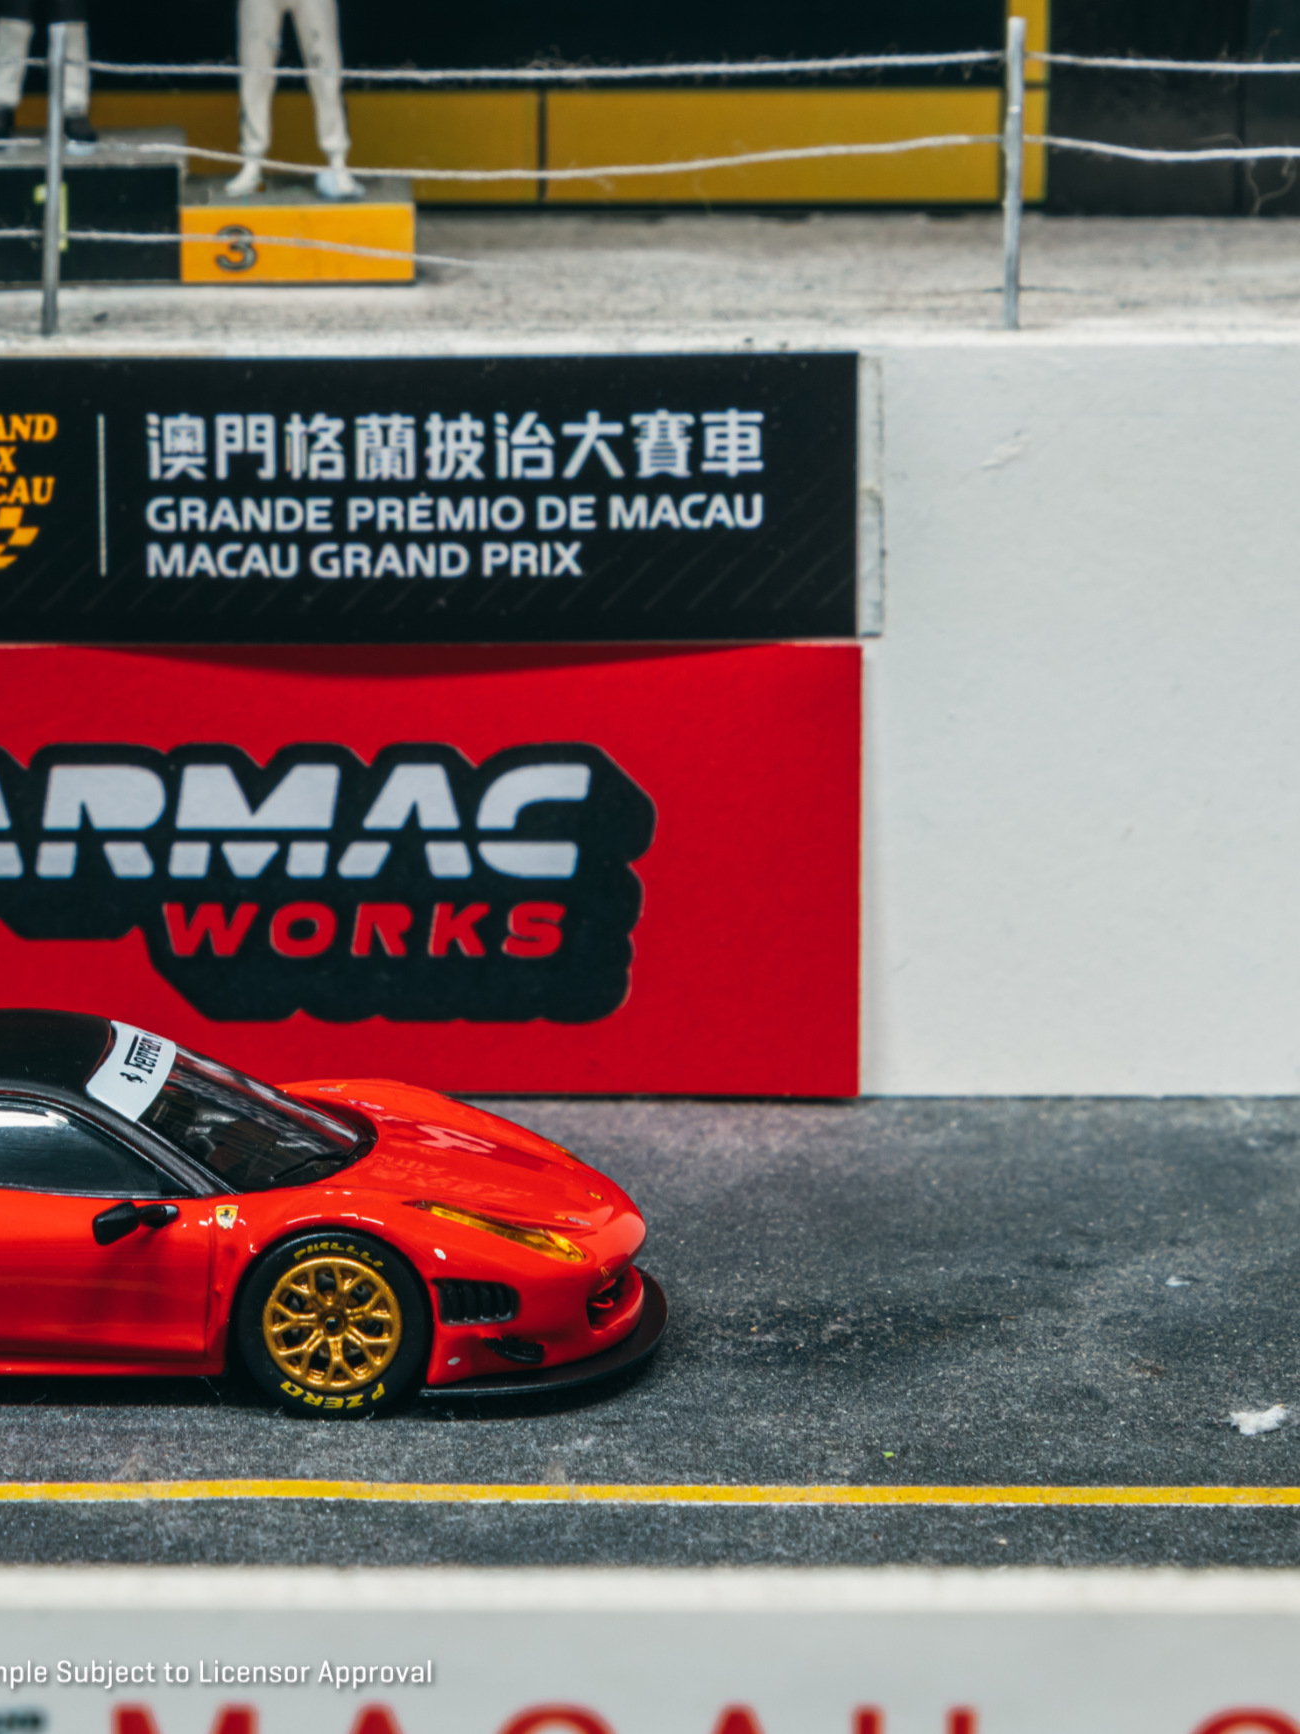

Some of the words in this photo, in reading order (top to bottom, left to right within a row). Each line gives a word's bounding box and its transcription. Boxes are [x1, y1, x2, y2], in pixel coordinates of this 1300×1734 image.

[215, 225, 257, 272] 3
[147, 409, 763, 479] 澳門格蘭披治大賽車
[147, 498, 332, 531] GRANDE
[537, 496, 595, 529] DE
[610, 494, 762, 529] MACAU
[148, 544, 298, 577] MACAU
[311, 543, 469, 577] GRAND
[483, 542, 581, 576] PRIX
[166, 903, 565, 957] WORKS
[280, 1381, 364, 1409] ZERO
[371, 1382, 385, 1400] P
